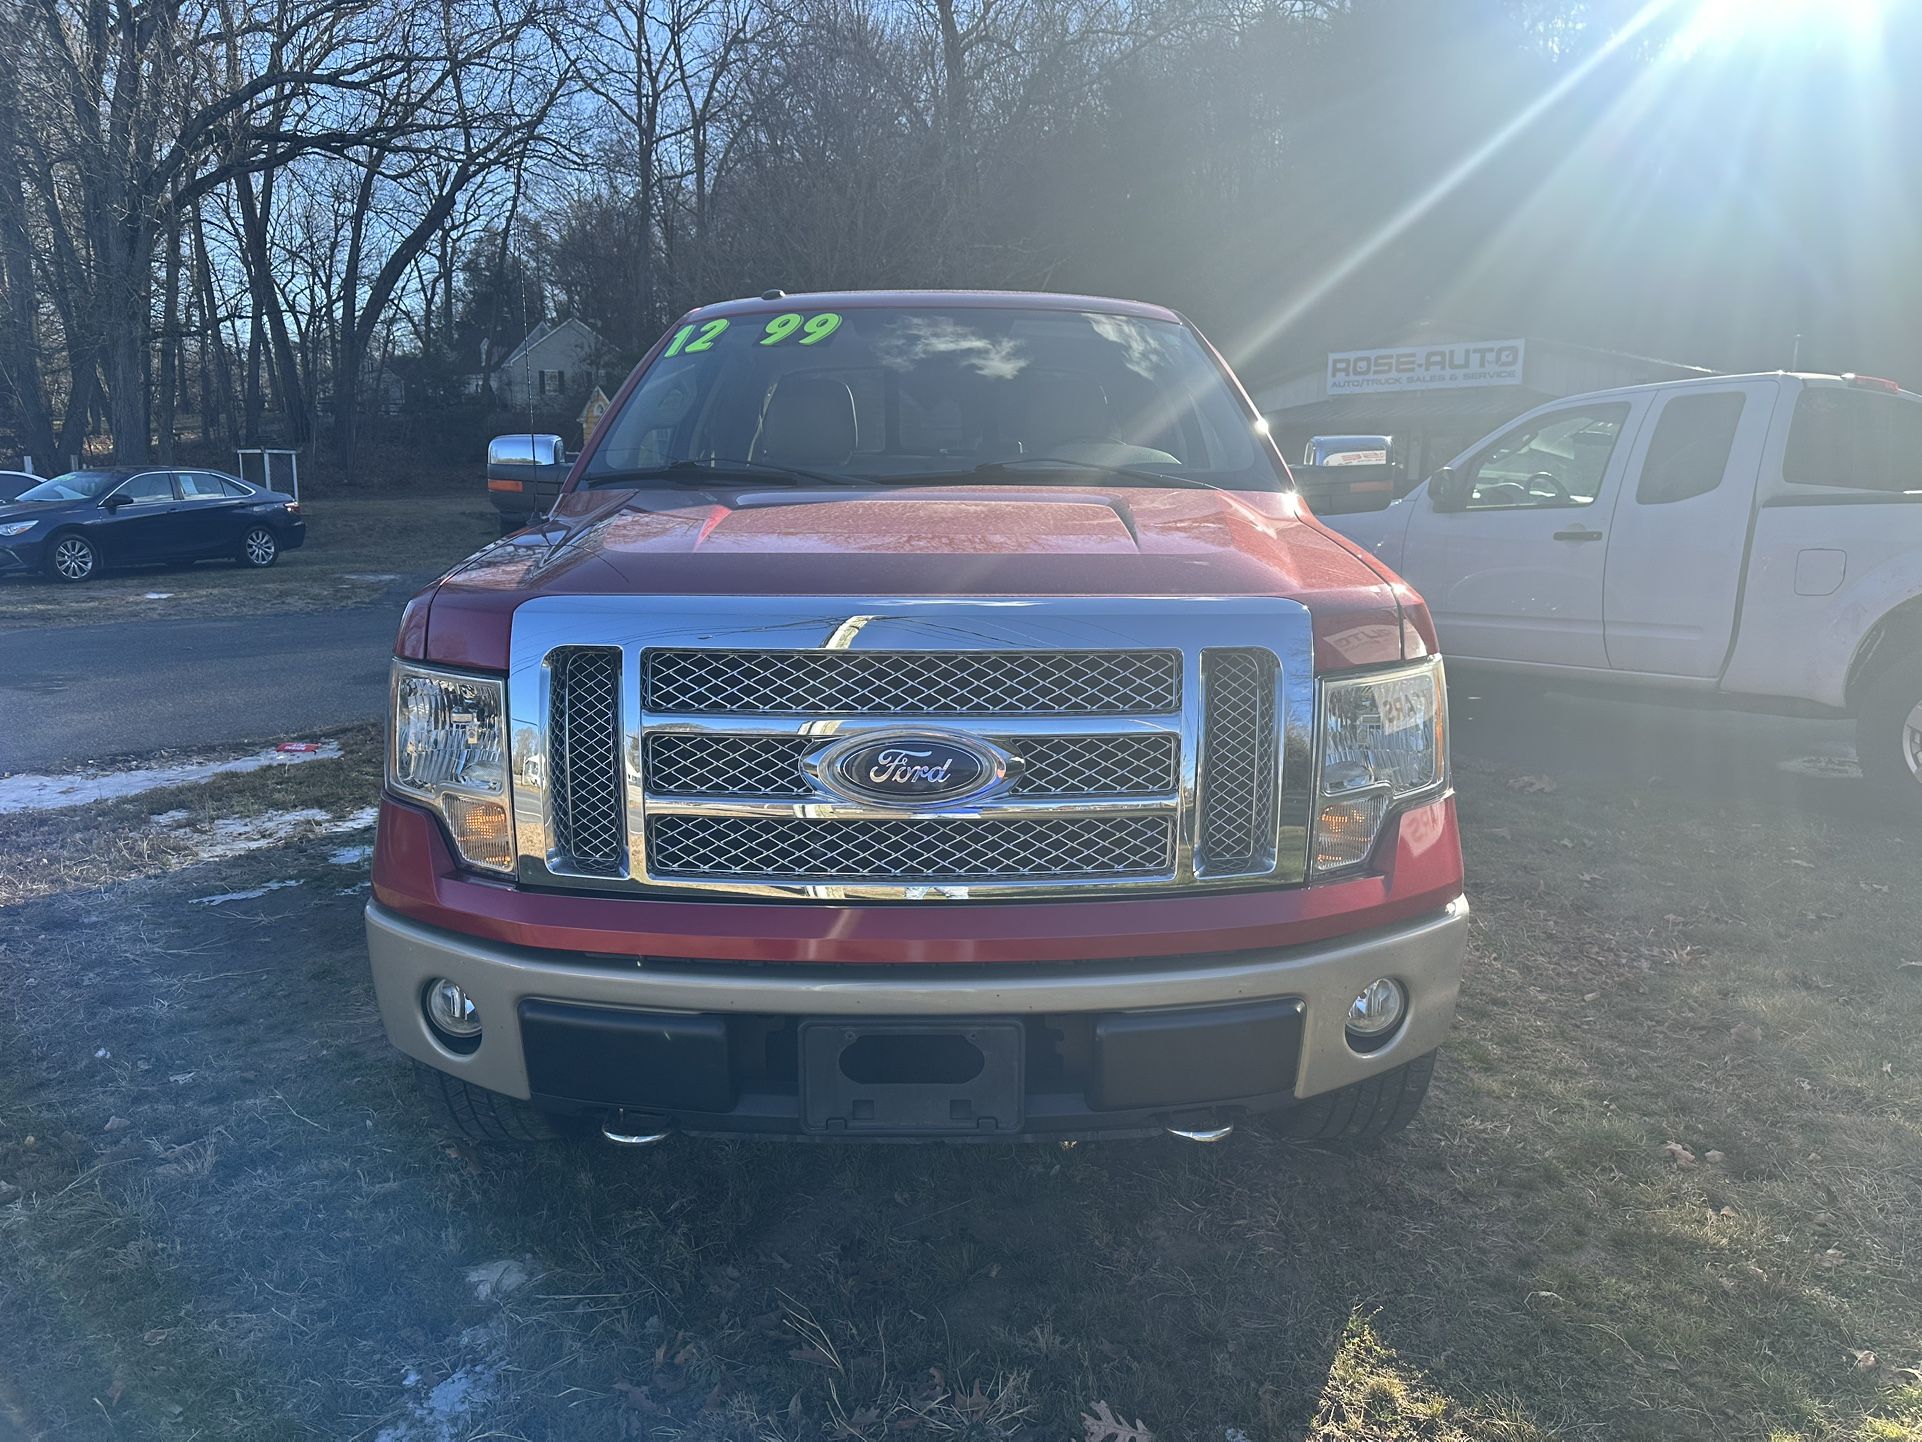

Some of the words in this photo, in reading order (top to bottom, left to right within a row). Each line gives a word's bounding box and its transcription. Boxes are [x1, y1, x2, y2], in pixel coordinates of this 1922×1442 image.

[664, 318, 731, 358] 12
[759, 313, 843, 346] 99
[1406, 373, 1446, 385] SALES
[1449, 372, 1459, 381] &
[1463, 369, 1516, 381] SERVICE
[869, 748, 952, 783] Ford
